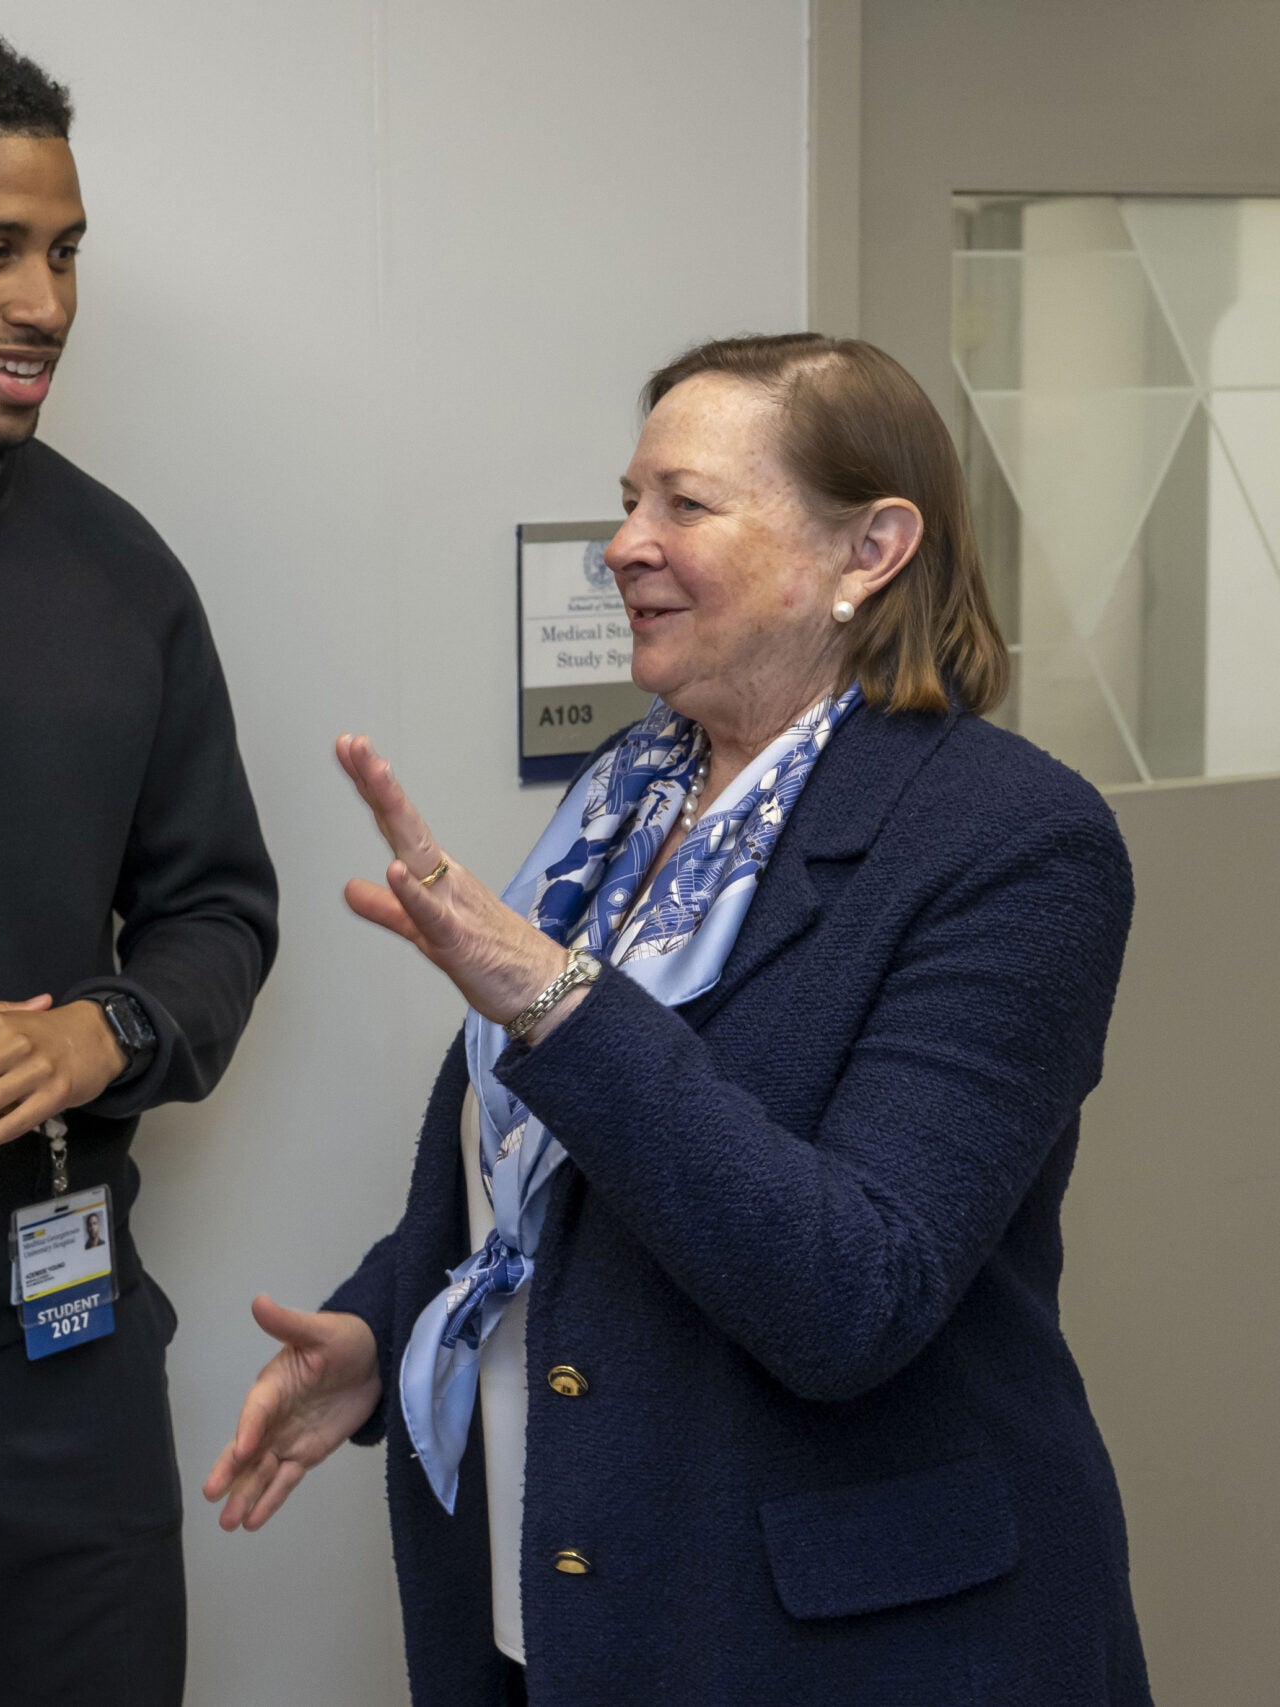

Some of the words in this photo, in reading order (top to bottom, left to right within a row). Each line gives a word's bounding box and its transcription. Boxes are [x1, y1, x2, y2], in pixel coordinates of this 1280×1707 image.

[541, 623, 602, 642] Medical
[606, 621, 632, 640] Stu
[556, 650, 603, 670] Study
[539, 703, 593, 727] A103
[37, 1293, 100, 1325] STUDENT
[51, 1311, 89, 1339] 2027
